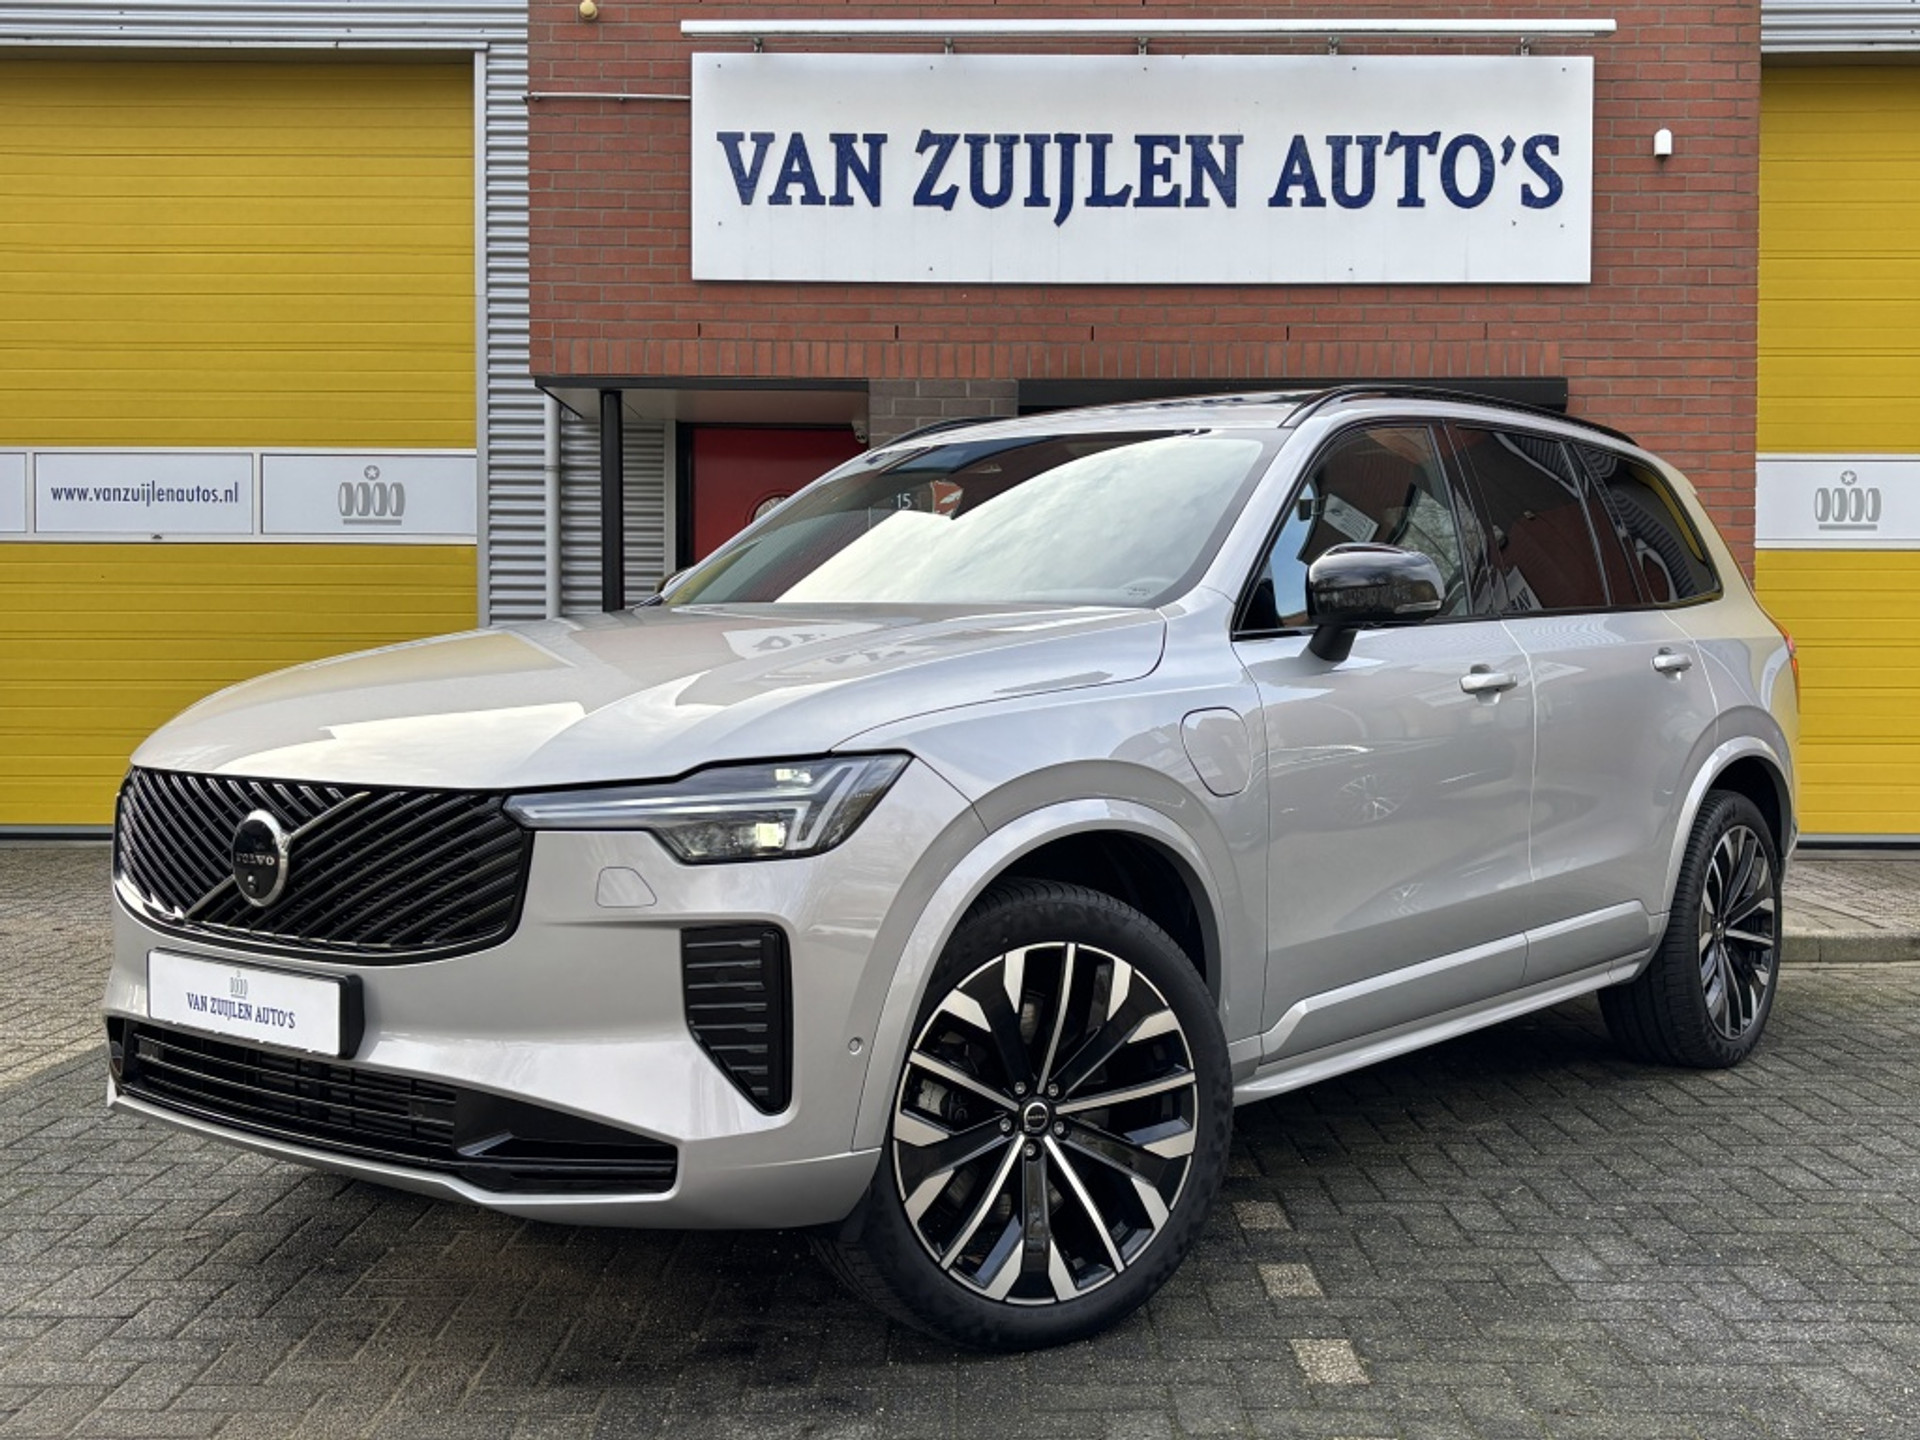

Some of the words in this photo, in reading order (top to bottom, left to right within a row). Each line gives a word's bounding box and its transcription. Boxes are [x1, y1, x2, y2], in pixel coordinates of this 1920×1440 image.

[717, 132, 887, 207] VAN
[913, 129, 1243, 227] ZUIJLEN
[1268, 131, 1563, 209] AUTO'S
[51, 480, 238, 507] www.vanzuijlenautos.nl
[187, 993, 207, 1011] VAN
[210, 995, 252, 1020] ZUIJLEN
[255, 1007, 295, 1028] AUTO'S
